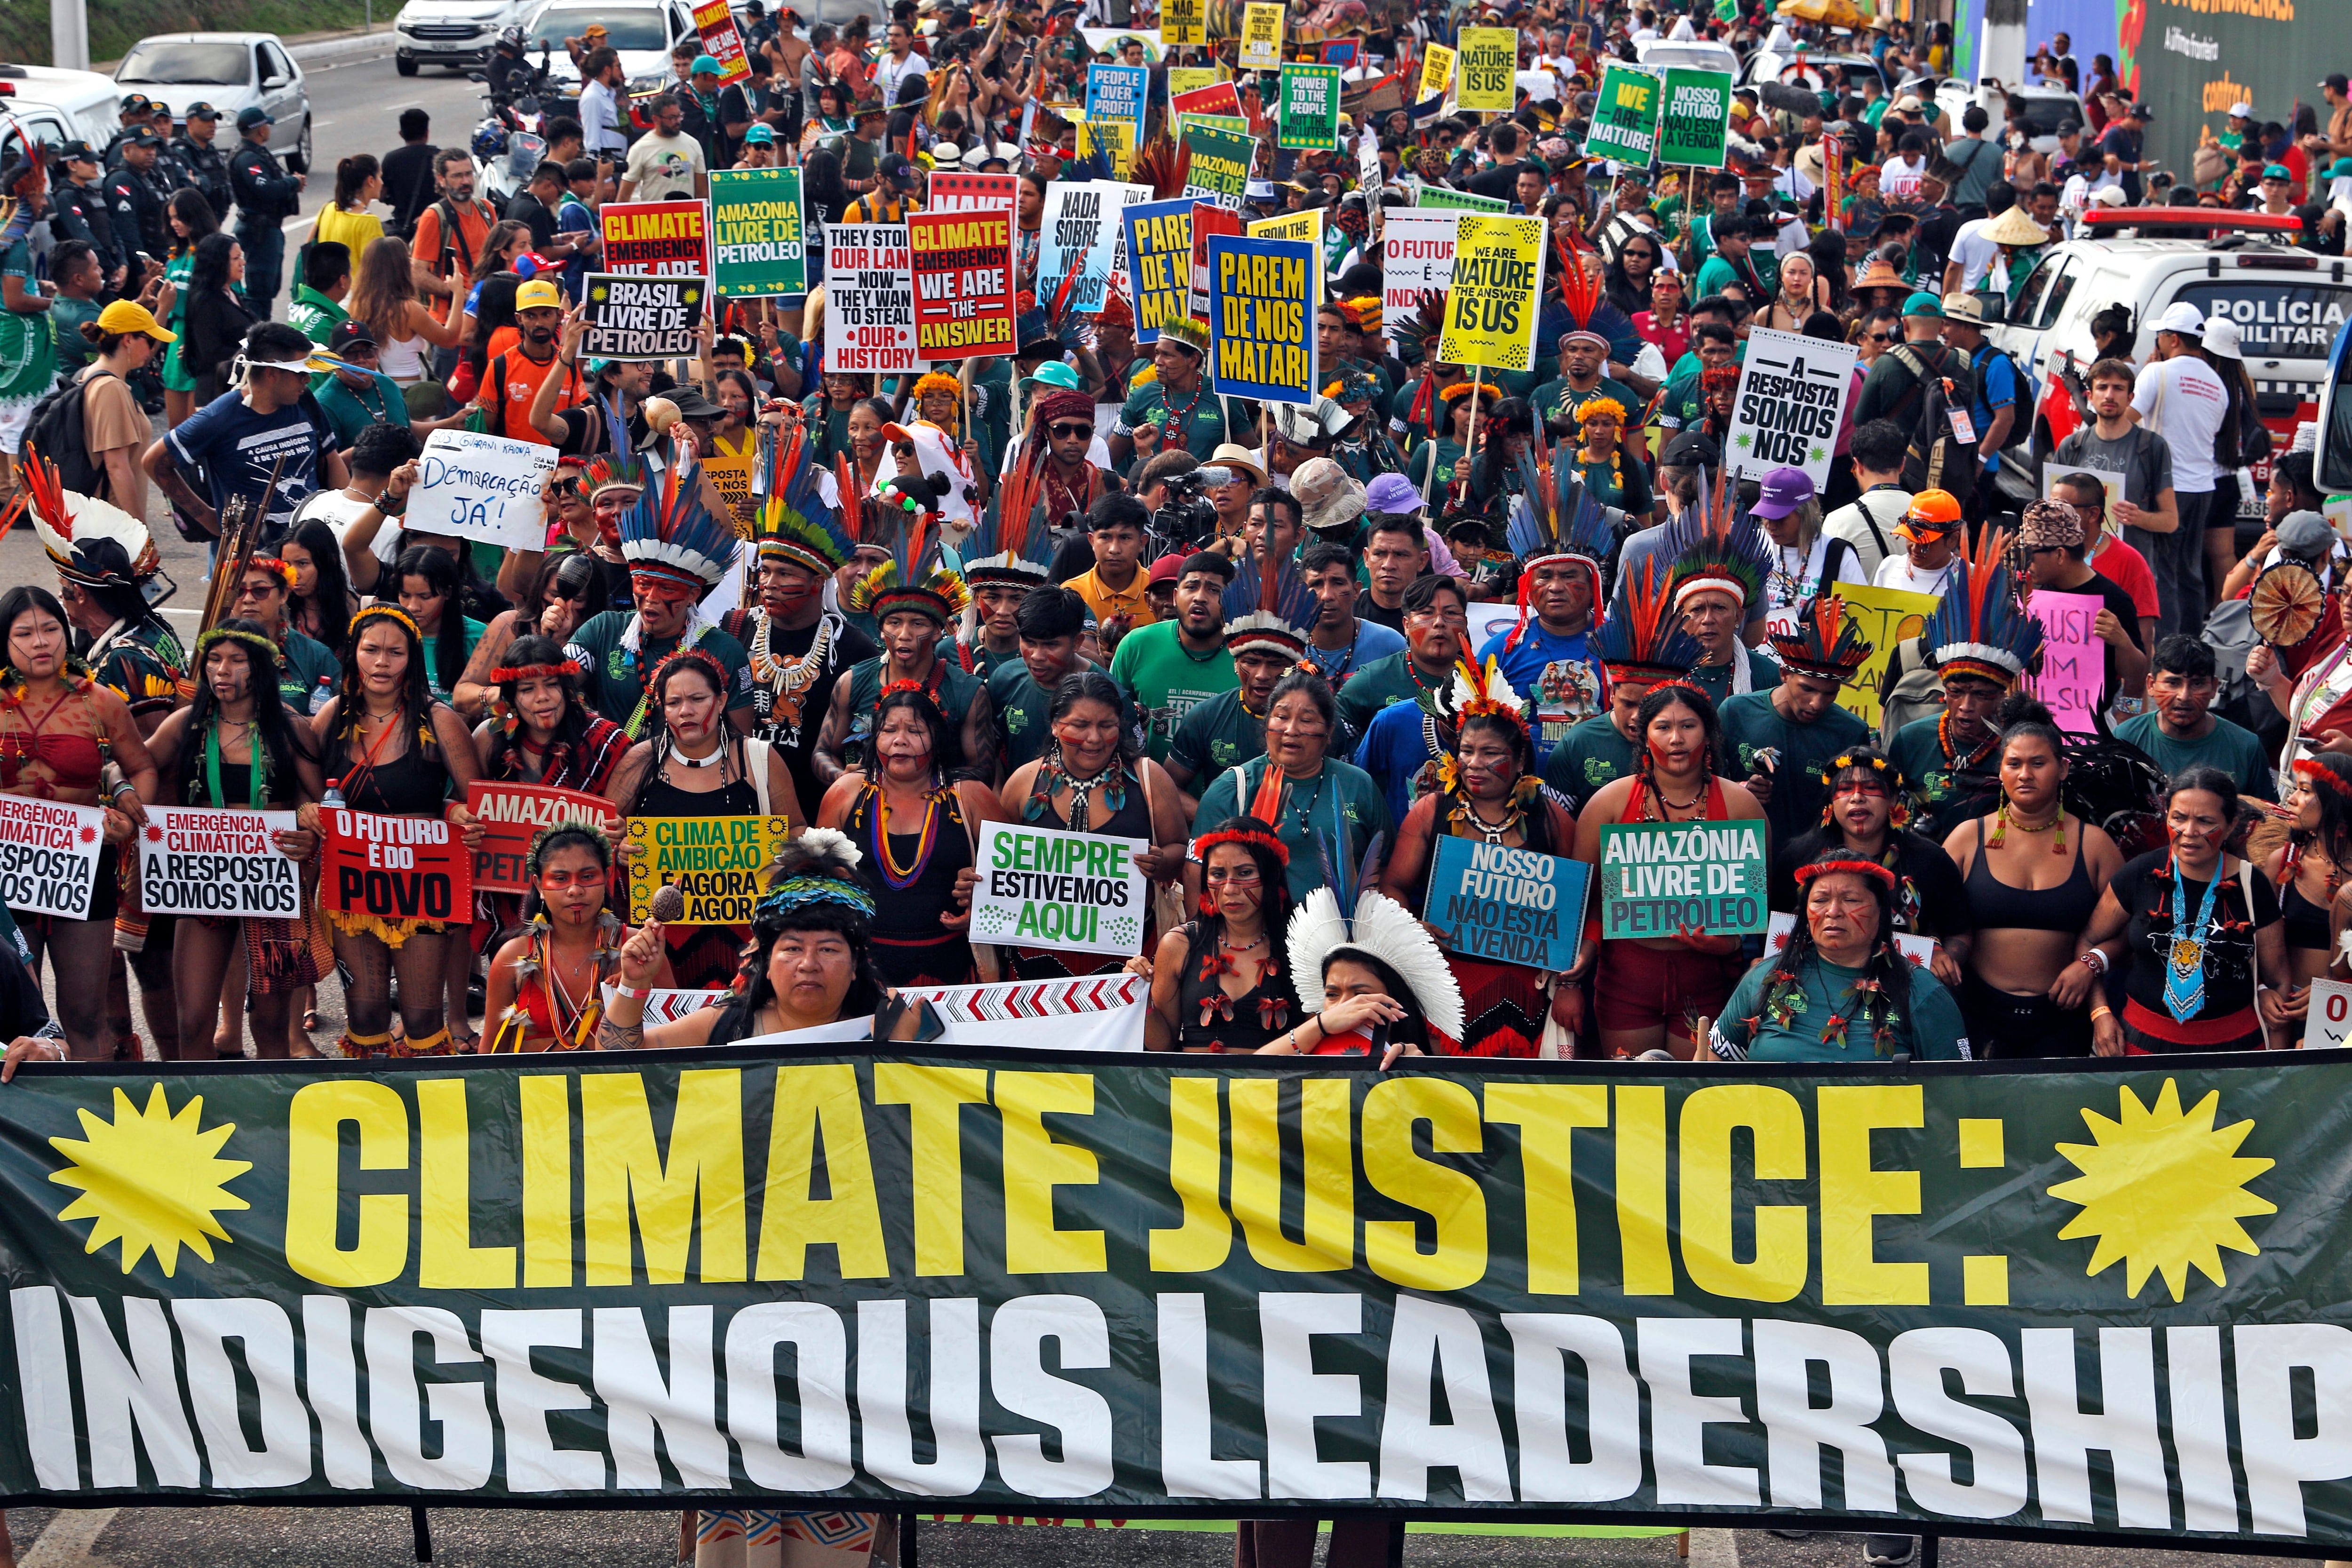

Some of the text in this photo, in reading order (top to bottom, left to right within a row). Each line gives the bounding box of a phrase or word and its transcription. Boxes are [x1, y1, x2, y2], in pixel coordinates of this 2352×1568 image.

[696, 2, 729, 29] CLIMATE
[1254, 25, 1261, 33] TO
[706, 30, 737, 55] WE ARE
[1251, 41, 1271, 56] END
[1429, 59, 1446, 72] AMAZON
[1430, 49, 1450, 63] FROM THE
[1460, 50, 1514, 68] NATURE
[1095, 70, 1139, 87] PEOPLE
[1291, 77, 1328, 90] POWER
[1435, 71, 1443, 80] THE
[1466, 72, 1481, 90] IS
[1484, 73, 1506, 92] US
[1100, 85, 1132, 101] OVER
[1293, 88, 1327, 103] TO THE
[1616, 82, 1650, 111] WE
[1674, 85, 1720, 105] NOSSO
[1093, 100, 1136, 116] PROFIT
[1289, 101, 1327, 115] PEOPLE
[1611, 106, 1641, 129] ARE
[1669, 101, 1722, 120] FUTURO
[1282, 124, 1333, 138] POLLUTERS
[1288, 114, 1327, 129] NOT THE
[1590, 122, 1653, 153] NATURE
[1677, 132, 1720, 150] VENDA
[1221, 177, 1241, 196] DE
[716, 201, 798, 223] AMAZÔNIA
[1060, 191, 1100, 219] NADA
[604, 212, 703, 241] CLIMATE
[716, 219, 800, 245] LIVRE DE
[830, 229, 870, 247] THEY
[912, 221, 1008, 251] CLIMATE
[1055, 220, 1102, 247] SOBRE
[1134, 212, 1192, 255] PARE
[1289, 220, 1309, 236] THE
[606, 239, 703, 262] EMERGENCY
[716, 239, 801, 264] PETRÓLEO
[831, 248, 908, 270] OUR LAN
[914, 247, 1008, 271] EMERGENCY
[1387, 239, 1454, 261] O FUTUR
[1475, 246, 1517, 259] WE ARE
[858, 271, 894, 289] NOW
[1140, 252, 1168, 291] DE
[1219, 252, 1305, 300] PAREM
[1423, 263, 1431, 281] É
[1450, 257, 1535, 290] NATURE
[609, 283, 682, 307] BRASIL
[918, 268, 1006, 301] WE ARE
[1454, 287, 1526, 302] THE ANSWER
[832, 290, 912, 307] THEY WAN
[949, 299, 977, 320] THE
[2211, 296, 2344, 325] POLÍCIA
[596, 305, 688, 330] LIVRE DE
[842, 308, 912, 325] TO STEAL
[1223, 295, 1304, 344] DE NOS
[1454, 297, 1519, 334] IS US
[587, 327, 692, 353] PETRÓLEO
[858, 327, 895, 347] OUR
[920, 318, 1012, 350] ANSWER
[837, 348, 915, 369] HISTORY
[1219, 338, 1309, 392] MATAR!
[1790, 357, 1804, 378] A
[1745, 371, 1839, 409] RESPOSTA
[1740, 394, 1836, 439] SOMOS
[255, 443, 278, 455] CAUSA
[278, 436, 310, 450] INDÍGENA
[261, 444, 310, 462] DE NÓS
[1753, 427, 1809, 465] NÓS
[723, 480, 747, 490] NÓS
[1389, 481, 1408, 493] Derechos
[1397, 487, 1408, 496] tierra
[451, 495, 505, 530] JÁ!
[279, 685, 307, 693] BRASIL
[167, 812, 267, 834] EMERGÊNCIA
[336, 810, 449, 845] O FUTURO
[655, 820, 760, 847] CLIMA DE
[167, 828, 268, 855] CLIMÁTICA
[1604, 825, 1760, 865] AMAZÔNIA
[368, 841, 414, 869] É DO
[656, 844, 761, 874] AMBIÇÃO
[991, 831, 1129, 879] SEMPRE
[1470, 843, 1555, 880] NOSSO
[145, 854, 292, 883] A RESPOSTA
[1621, 863, 1745, 897] LIVRE DE
[144, 880, 295, 912] SOMOS NÓS
[339, 865, 452, 918] POVO
[680, 871, 759, 897] AGORA
[990, 870, 1129, 907] ESTIVEMOS
[1460, 869, 1556, 911] FUTURO
[37, 880, 88, 914] NÓS
[689, 896, 755, 921] AGOR
[1014, 901, 1099, 943] AQUI
[1446, 894, 1558, 940] NÃO ESTÁ
[1611, 894, 1758, 932] PETRÓLEO
[1470, 927, 1549, 967] VENDA
[285, 1063, 2009, 1307] CLIMATE JUSTICE:
[9, 1284, 2352, 1537] INDIGENOUS LEADERSHIP
